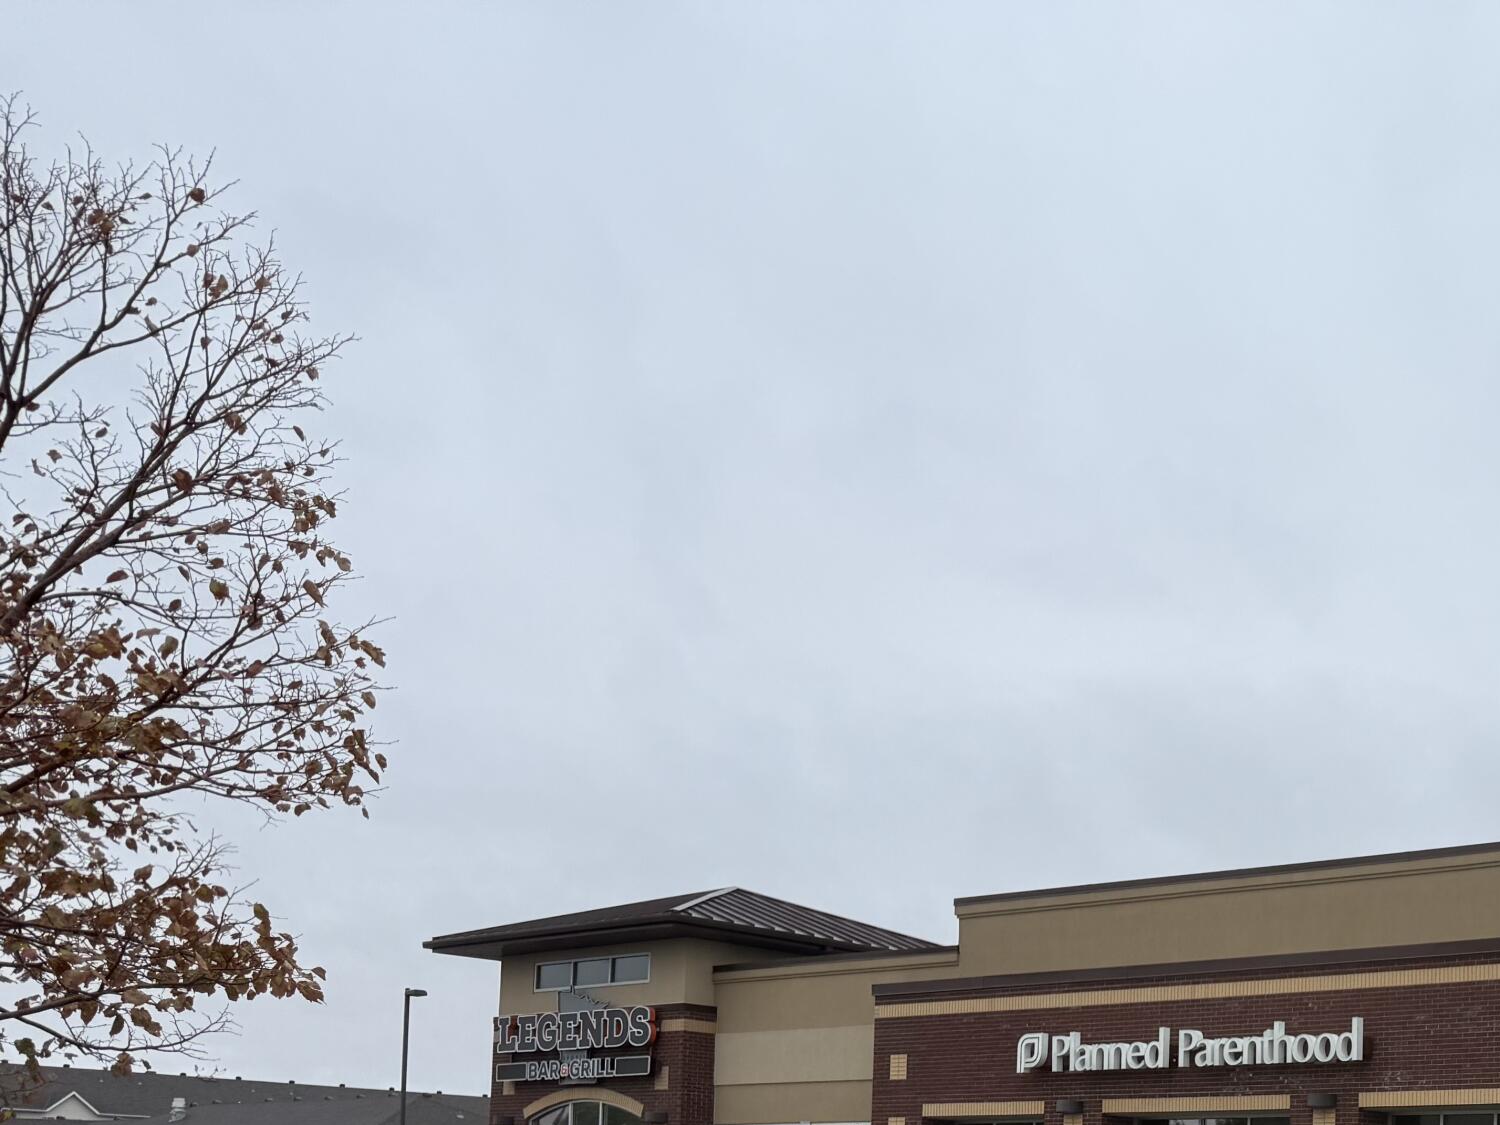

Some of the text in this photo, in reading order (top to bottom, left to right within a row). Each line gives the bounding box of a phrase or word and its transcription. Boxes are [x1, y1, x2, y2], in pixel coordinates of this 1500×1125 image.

[497, 1005, 652, 1053] LEGENDS
[1051, 1027, 1171, 1073] Planned
[1178, 1016, 1364, 1068] Parenthood
[527, 1060, 560, 1081] BAR
[569, 1057, 615, 1080] GRILL
